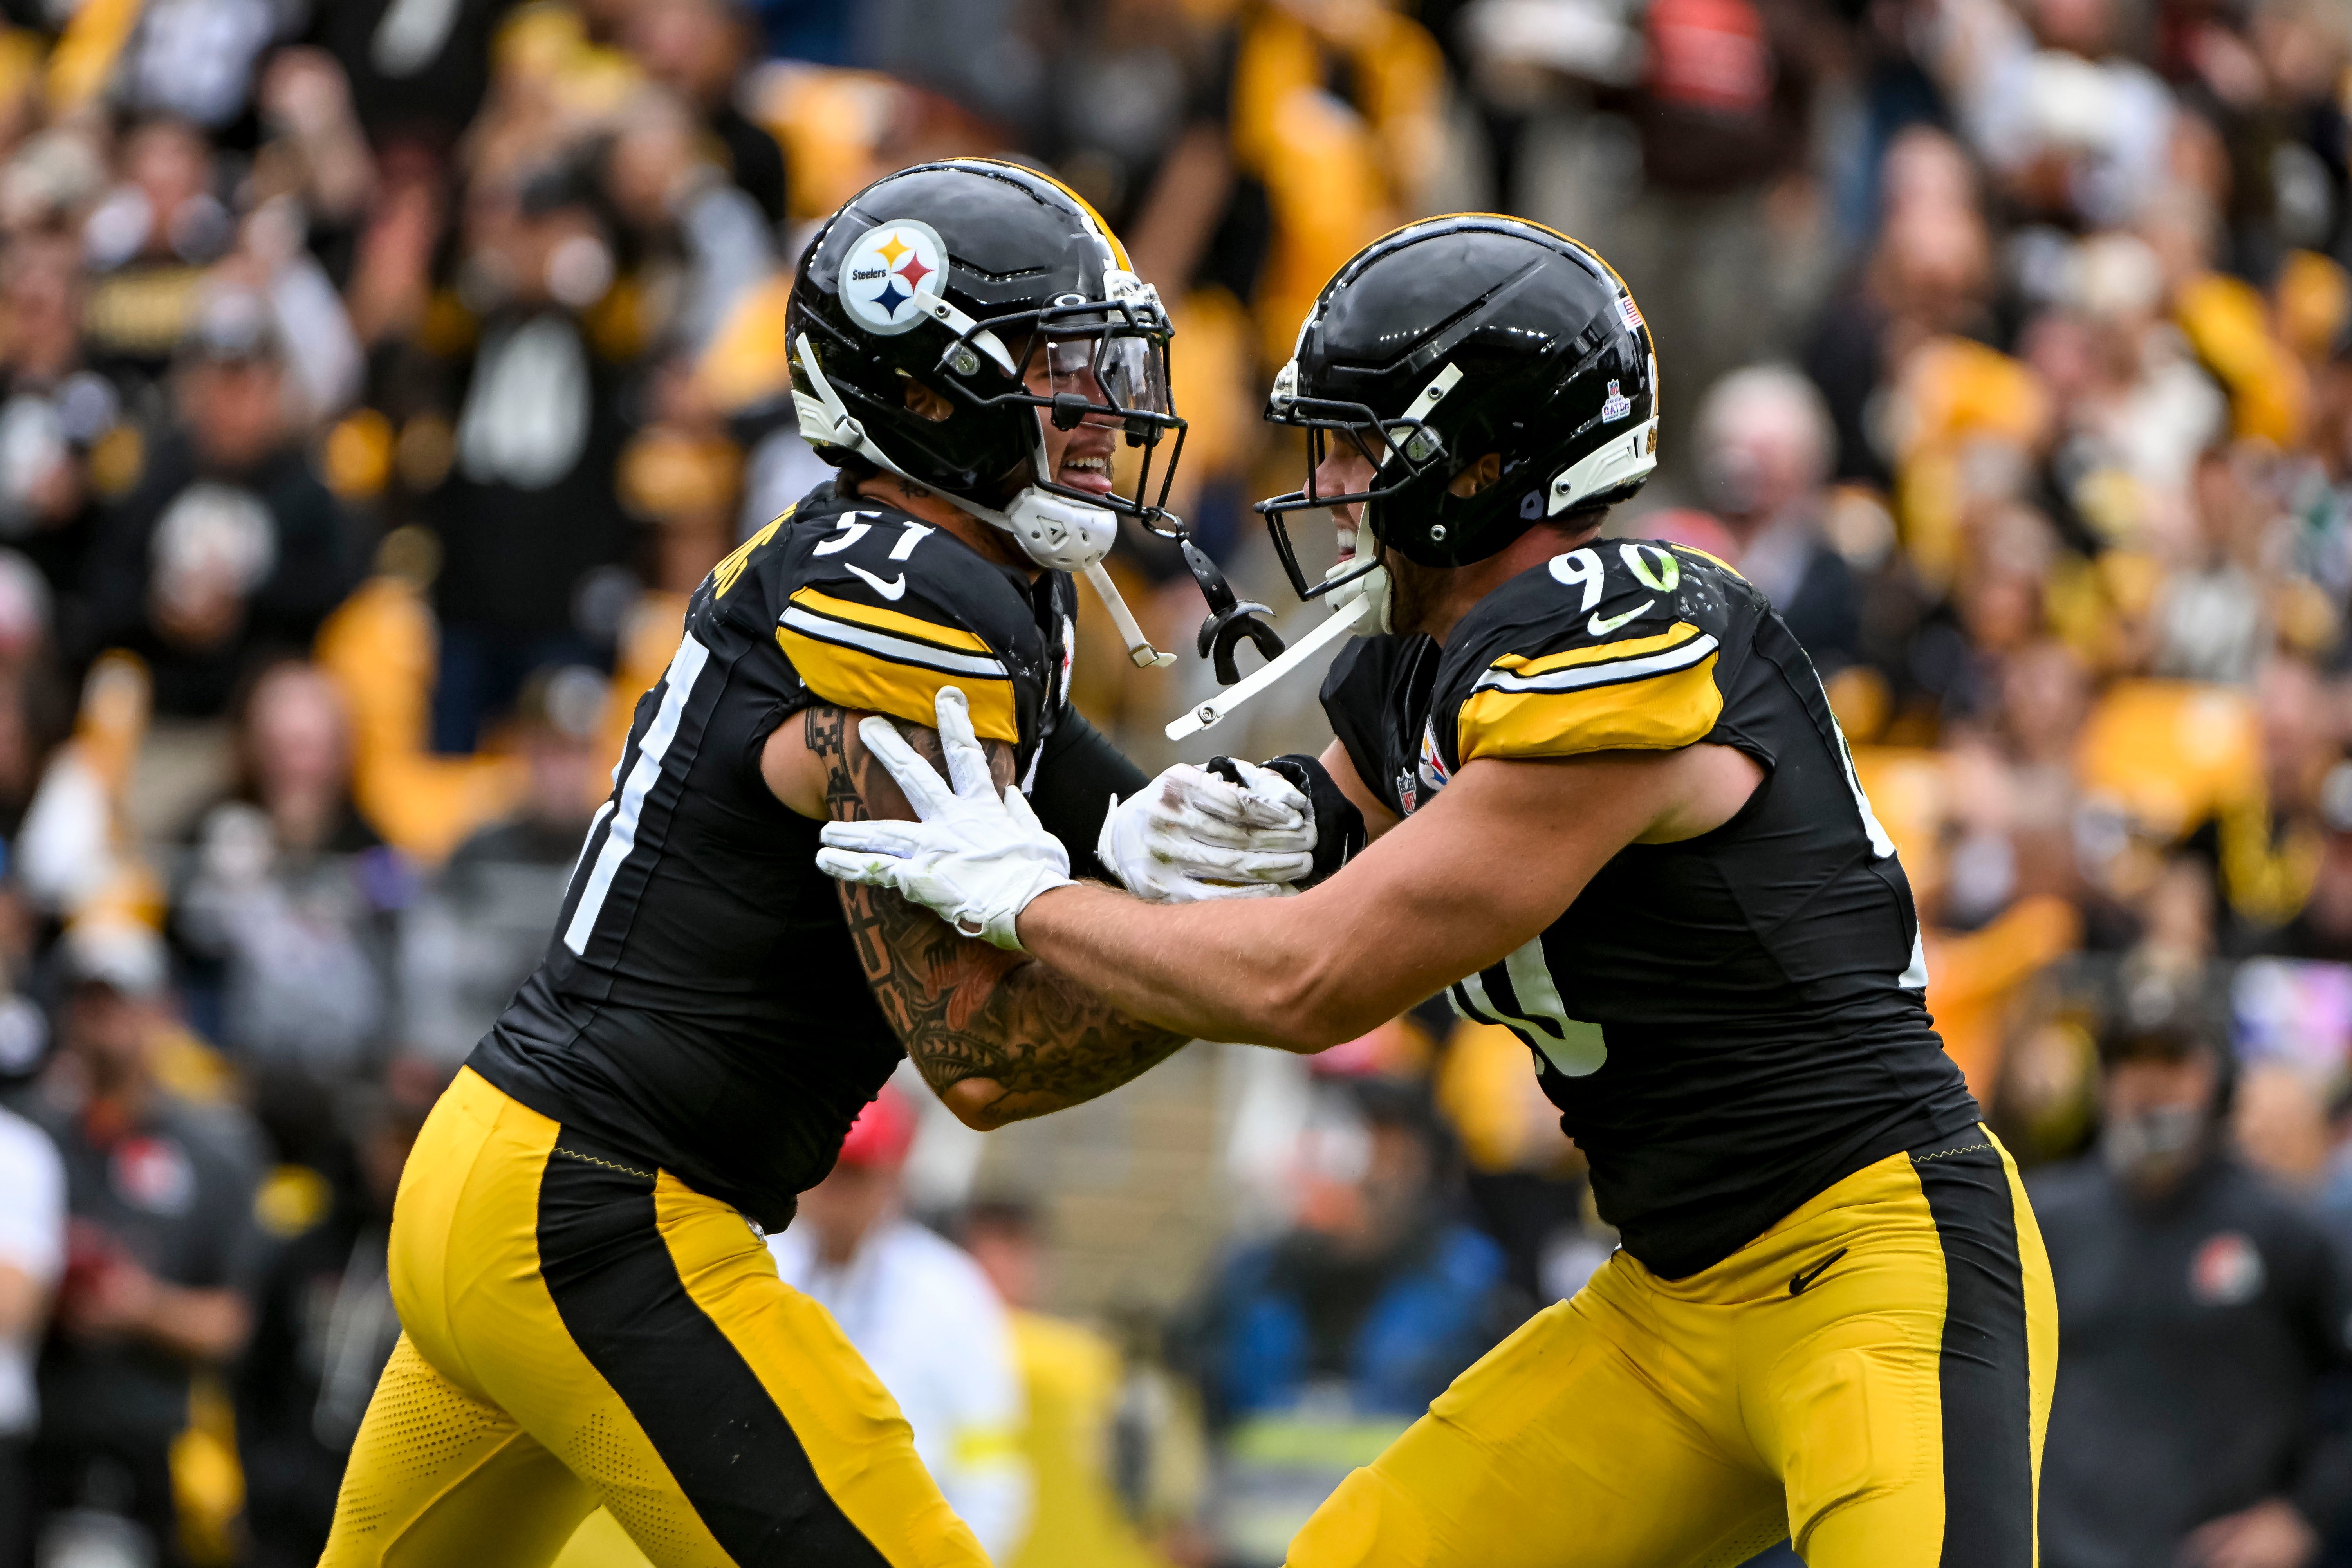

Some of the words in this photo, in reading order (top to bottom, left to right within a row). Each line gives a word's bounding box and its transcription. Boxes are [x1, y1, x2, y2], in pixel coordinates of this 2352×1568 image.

[852, 267, 886, 281] Steelers
[1603, 399, 1629, 416] CATCH
[1548, 543, 1679, 612] 90
